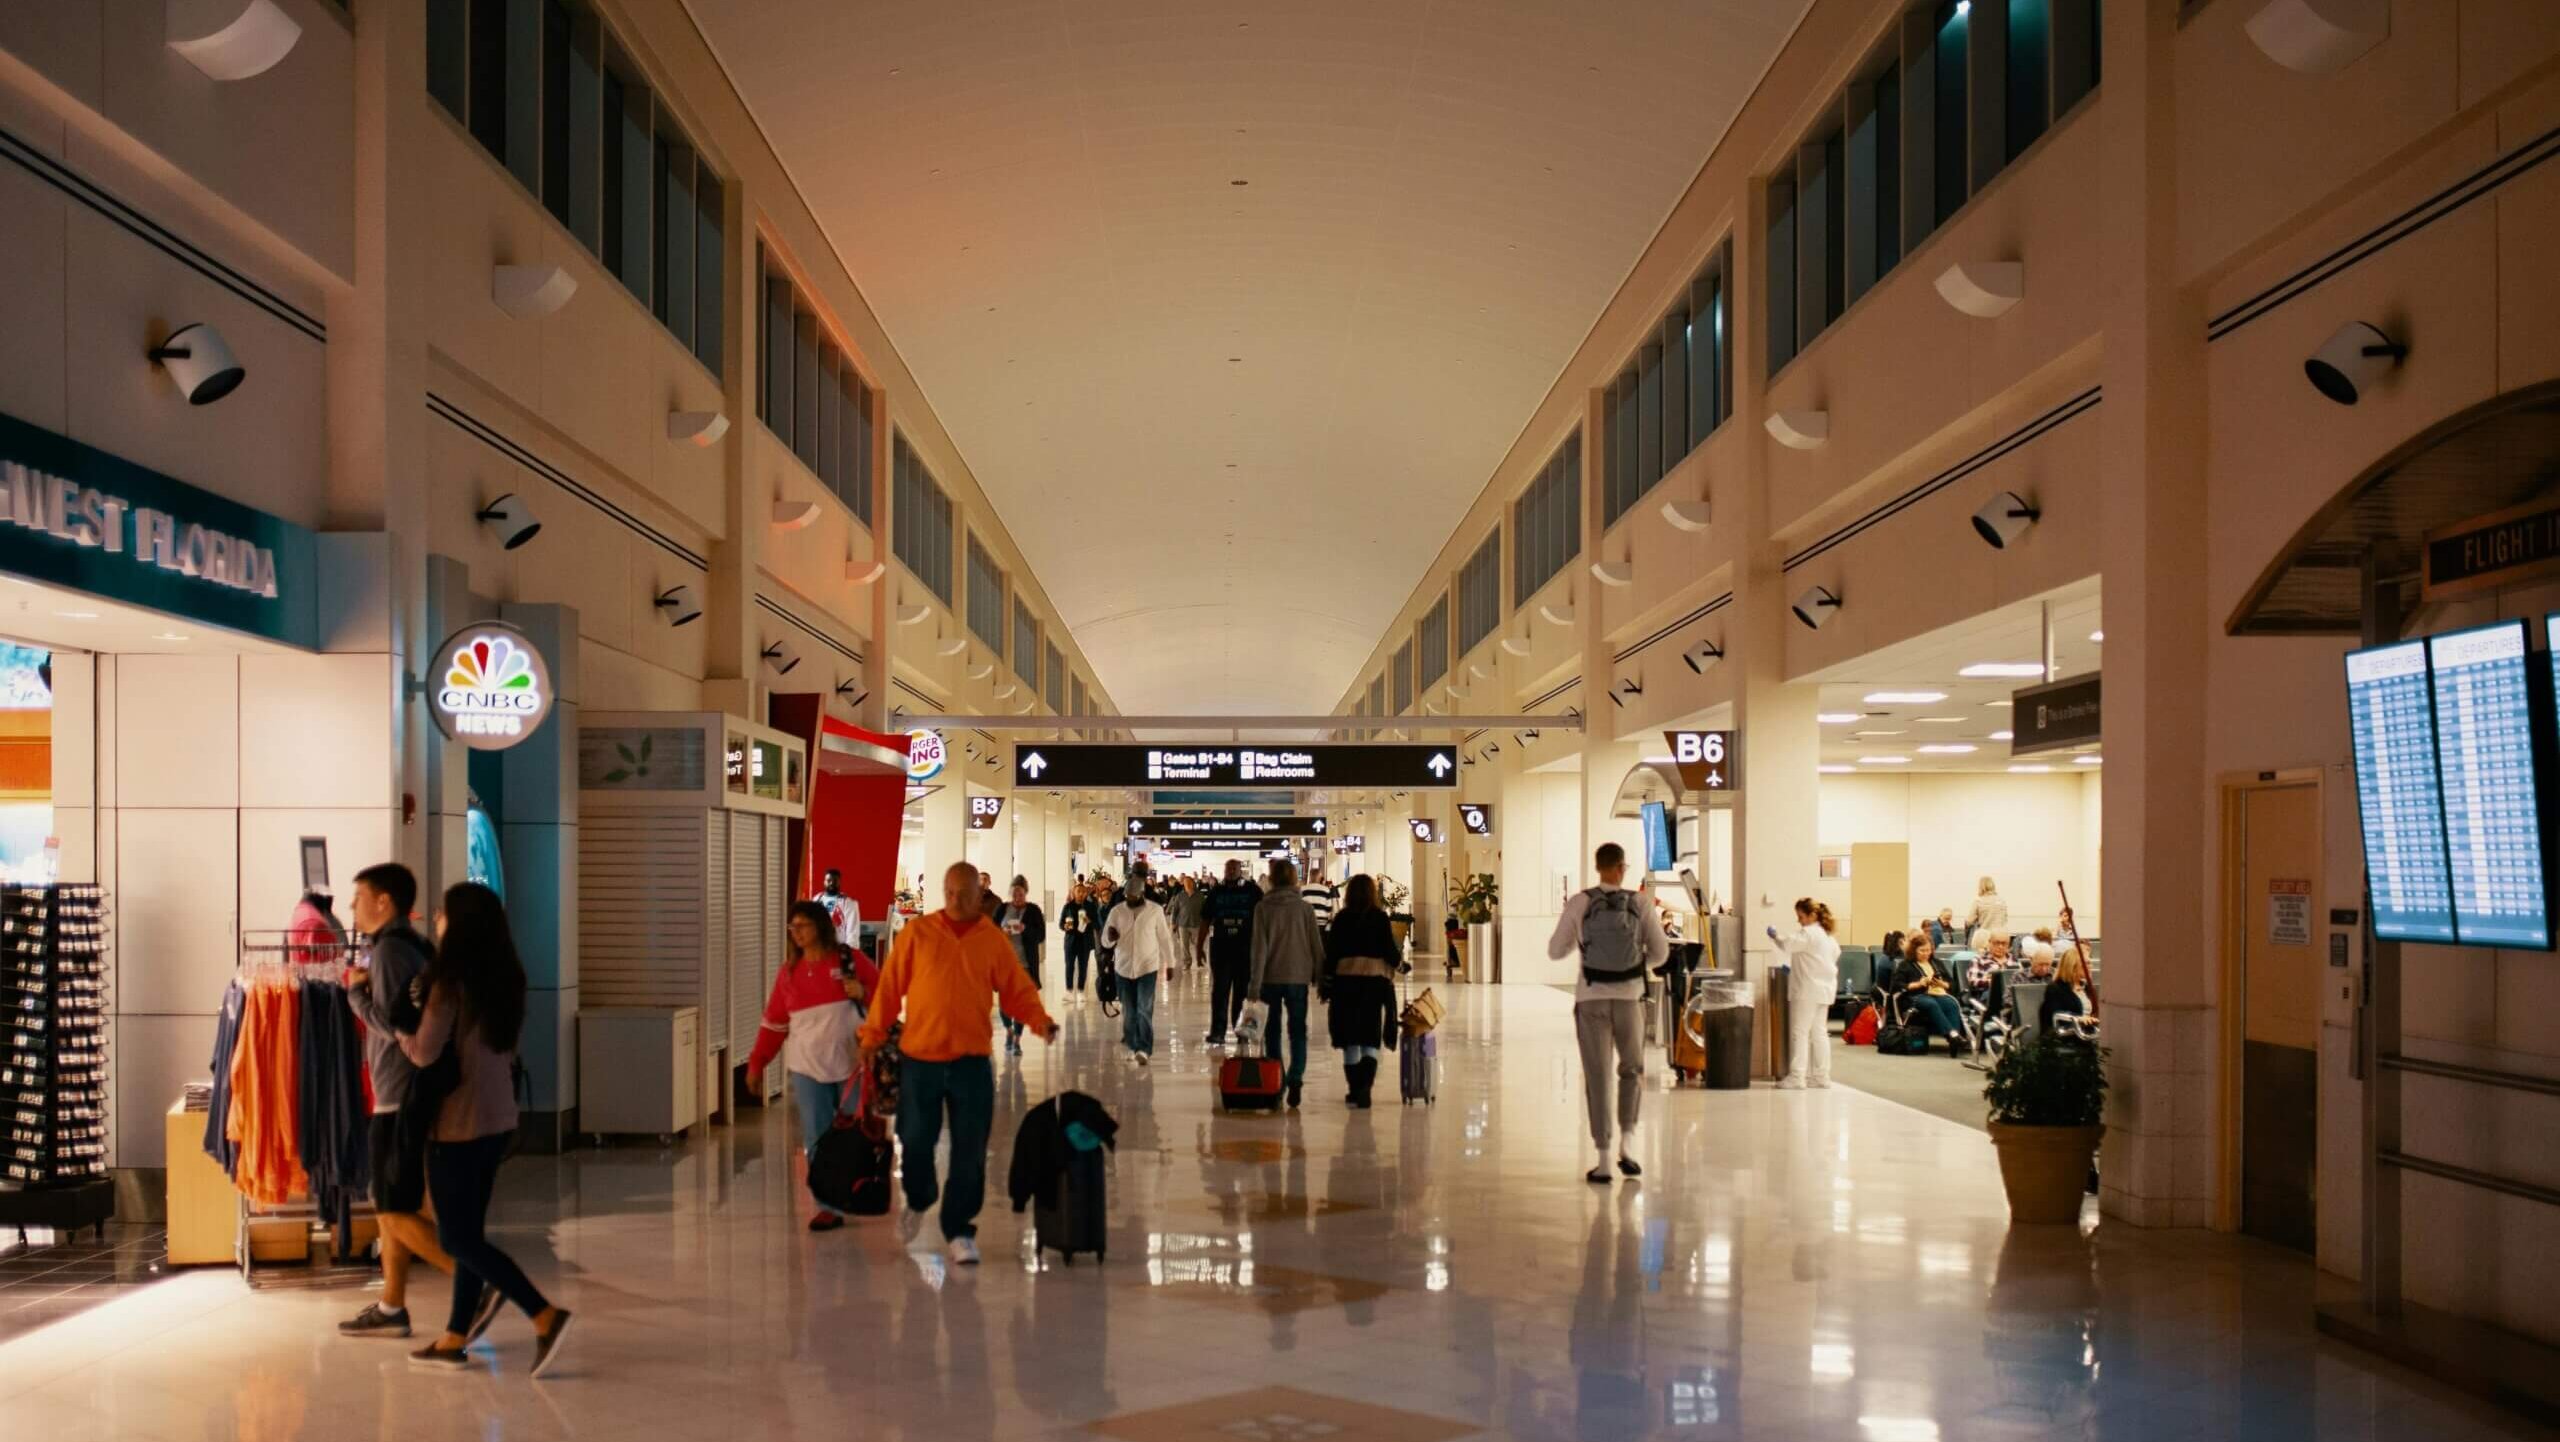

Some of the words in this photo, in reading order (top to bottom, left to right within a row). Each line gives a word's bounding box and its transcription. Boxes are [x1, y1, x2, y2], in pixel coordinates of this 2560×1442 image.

[135, 508, 278, 598] FLORIDA
[2464, 522, 2537, 571] FLIGHT
[442, 691, 535, 709] CNBC
[456, 713, 521, 735] NEWS
[912, 737, 938, 751] RGER
[1677, 733, 1724, 763] B6
[912, 746, 940, 765] ING
[1163, 753, 1196, 765] Gates
[1198, 753, 1234, 765] B1-B4
[1256, 753, 1278, 767] Bag
[1280, 753, 1313, 765] Claim
[1163, 768, 1210, 778] Terminal
[1256, 768, 1315, 778] Restrooms
[972, 798, 998, 815] B3
[1347, 836, 1361, 846] B4
